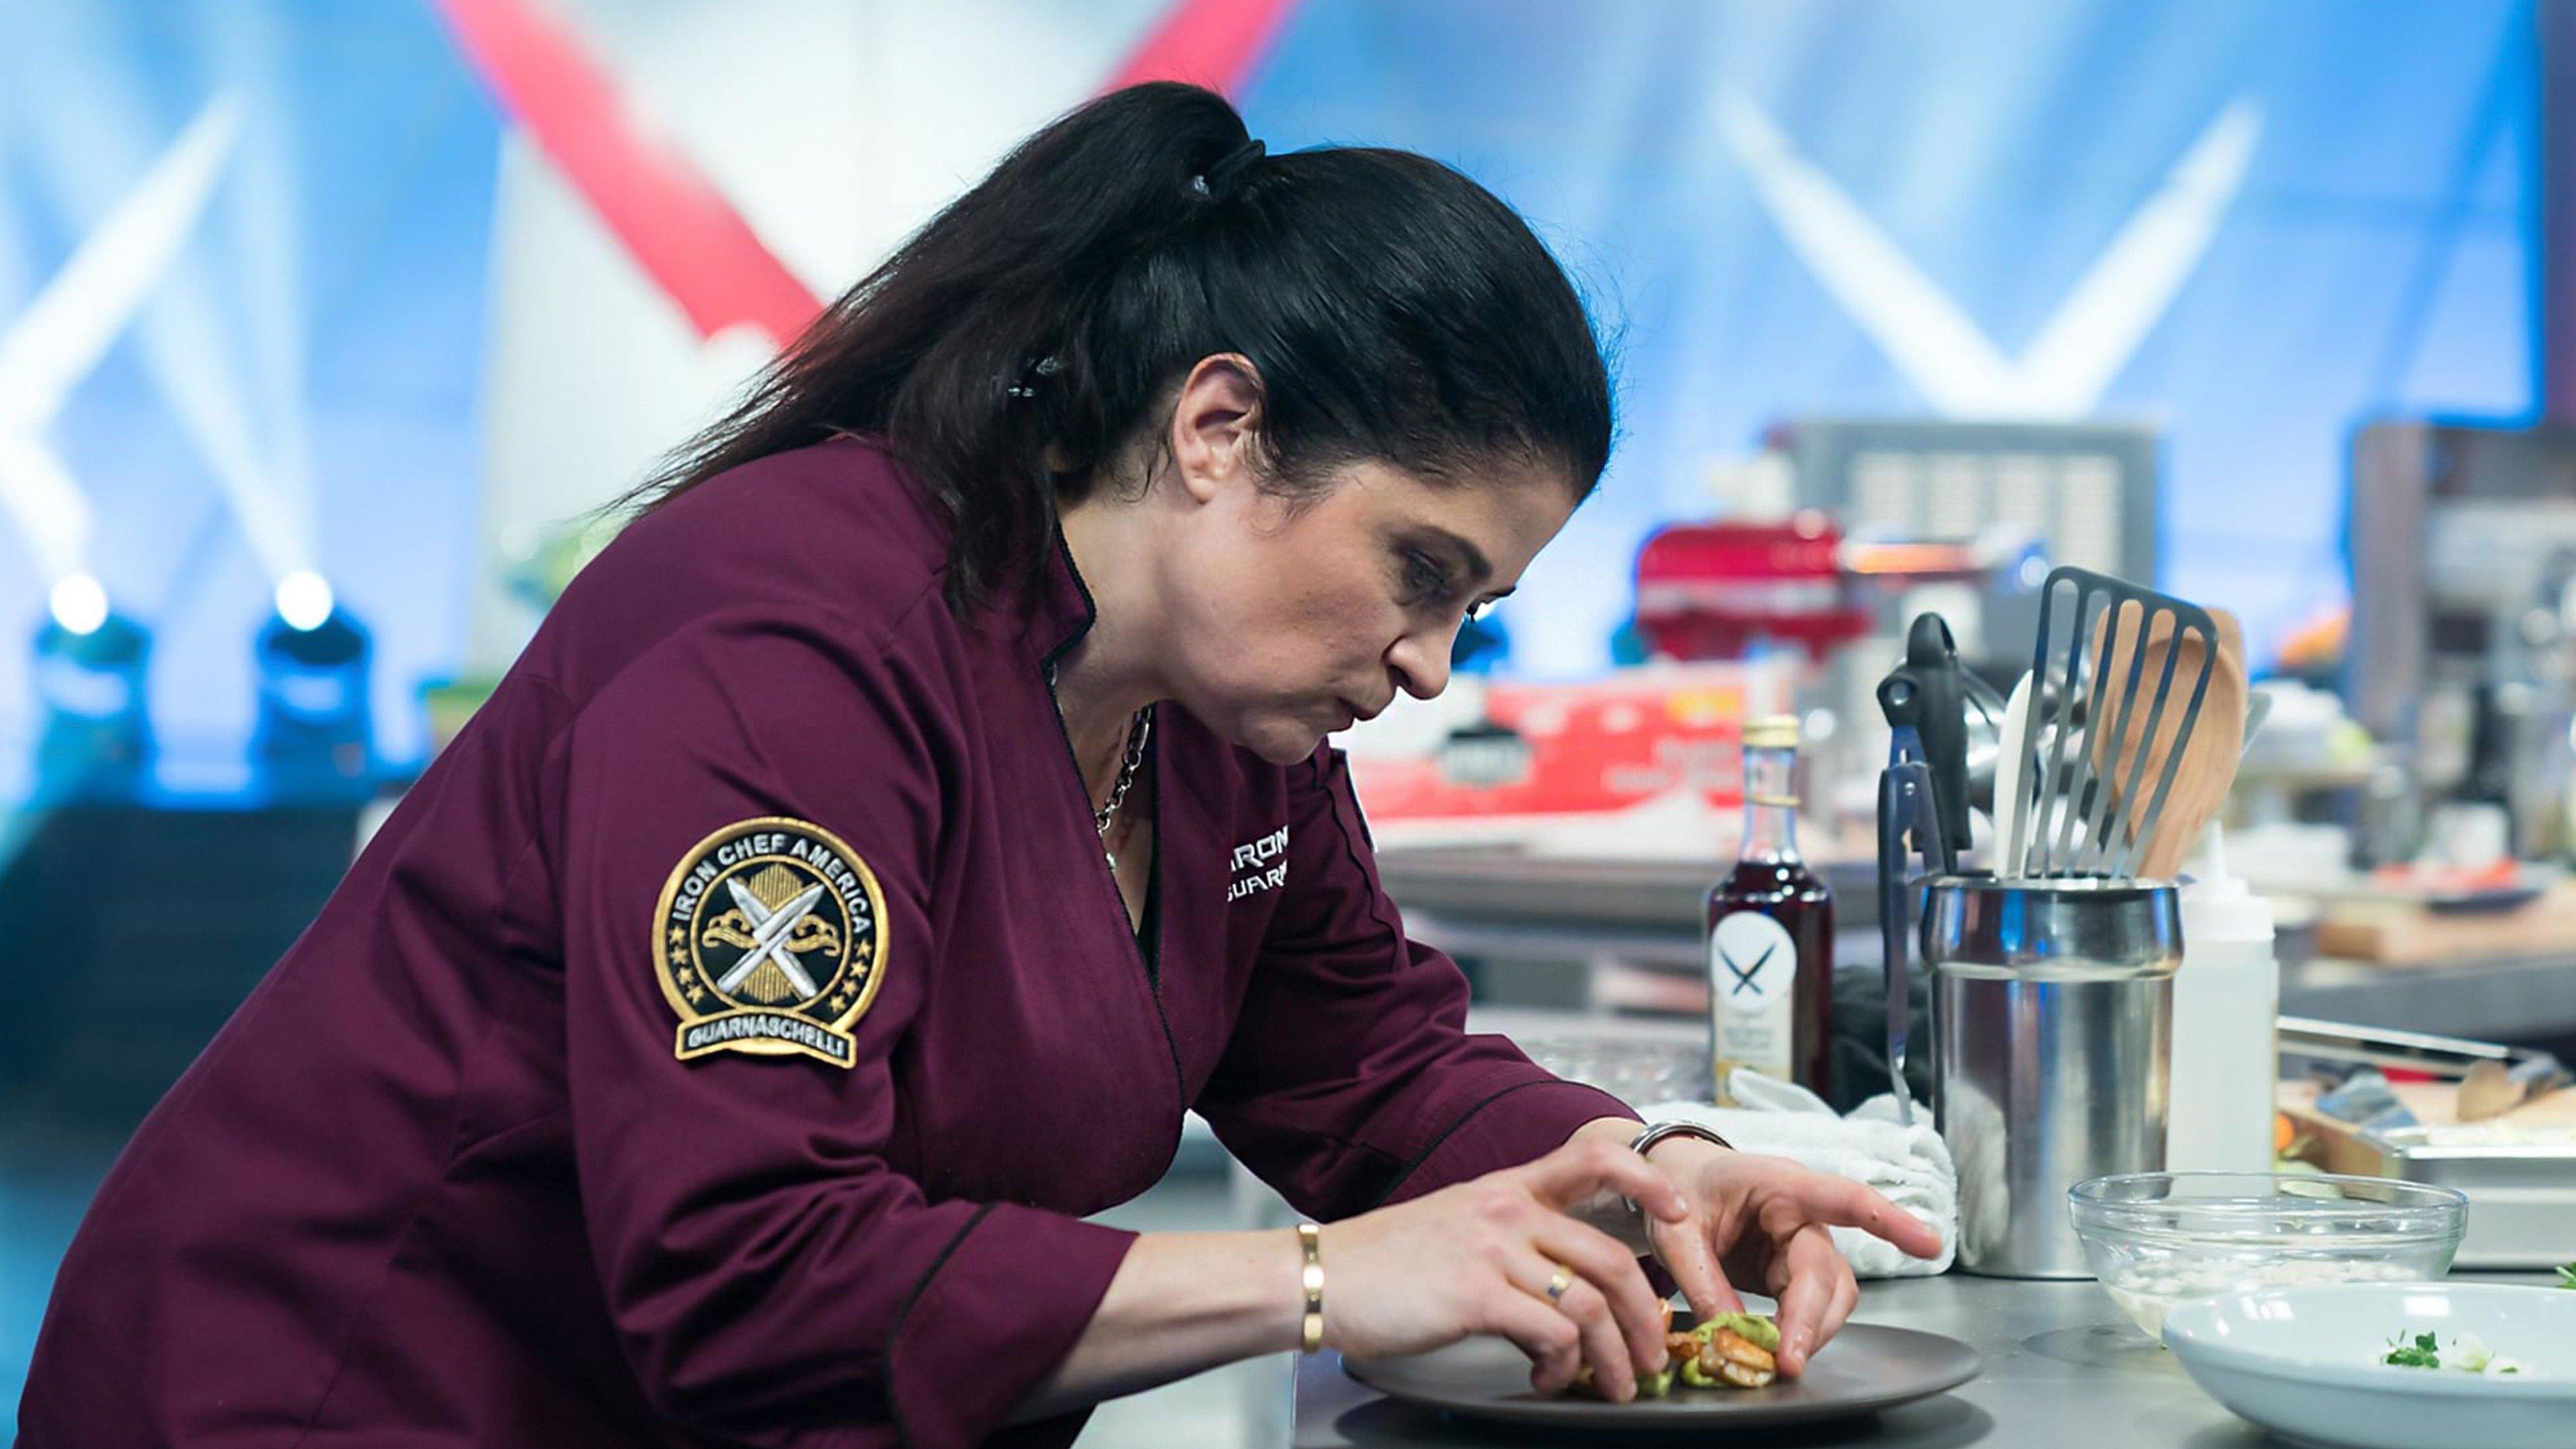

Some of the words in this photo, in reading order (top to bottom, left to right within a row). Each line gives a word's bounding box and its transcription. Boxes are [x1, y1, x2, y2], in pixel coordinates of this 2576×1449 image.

[673, 861, 718, 920] IRON
[718, 834, 786, 863] CHEF
[790, 840, 871, 932] AMERICA
[688, 1015, 845, 1057] GUARNASCHELLI
